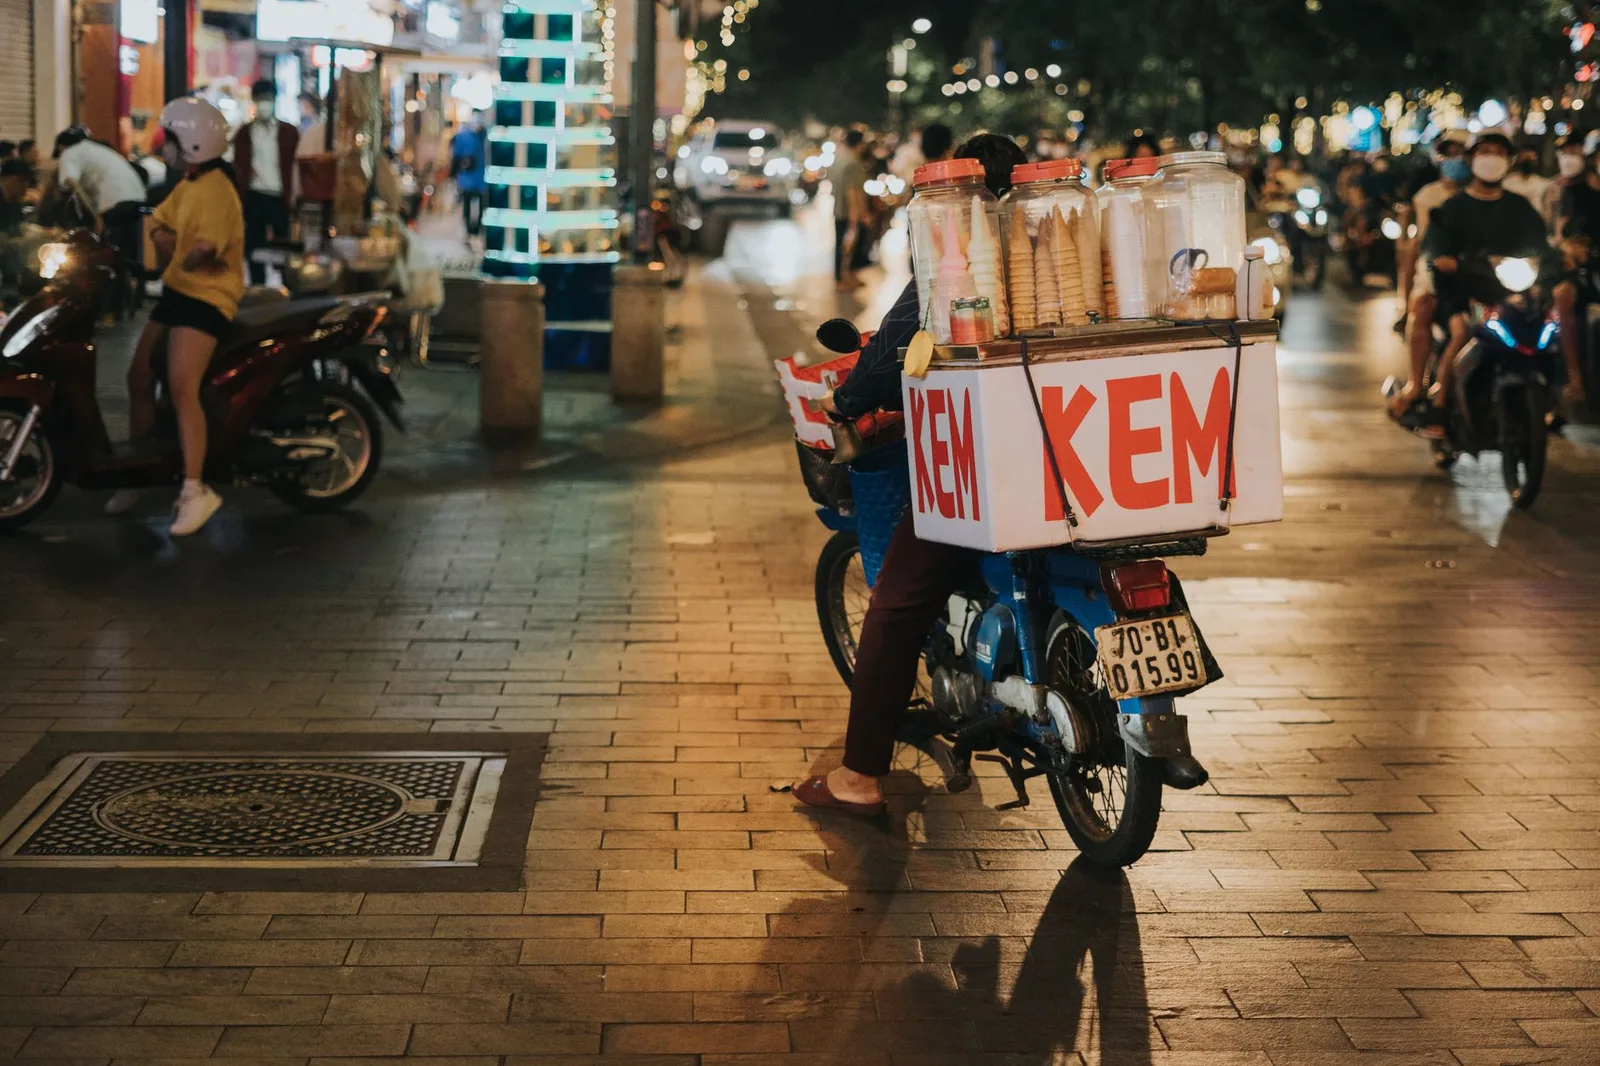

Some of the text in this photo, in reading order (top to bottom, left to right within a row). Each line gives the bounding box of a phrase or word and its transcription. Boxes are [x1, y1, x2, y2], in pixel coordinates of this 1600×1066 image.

[908, 386, 981, 522] KEM
[1041, 366, 1237, 522] KEM
[1111, 619, 1182, 659] 70-B1
[1111, 650, 1198, 693] 015.99
